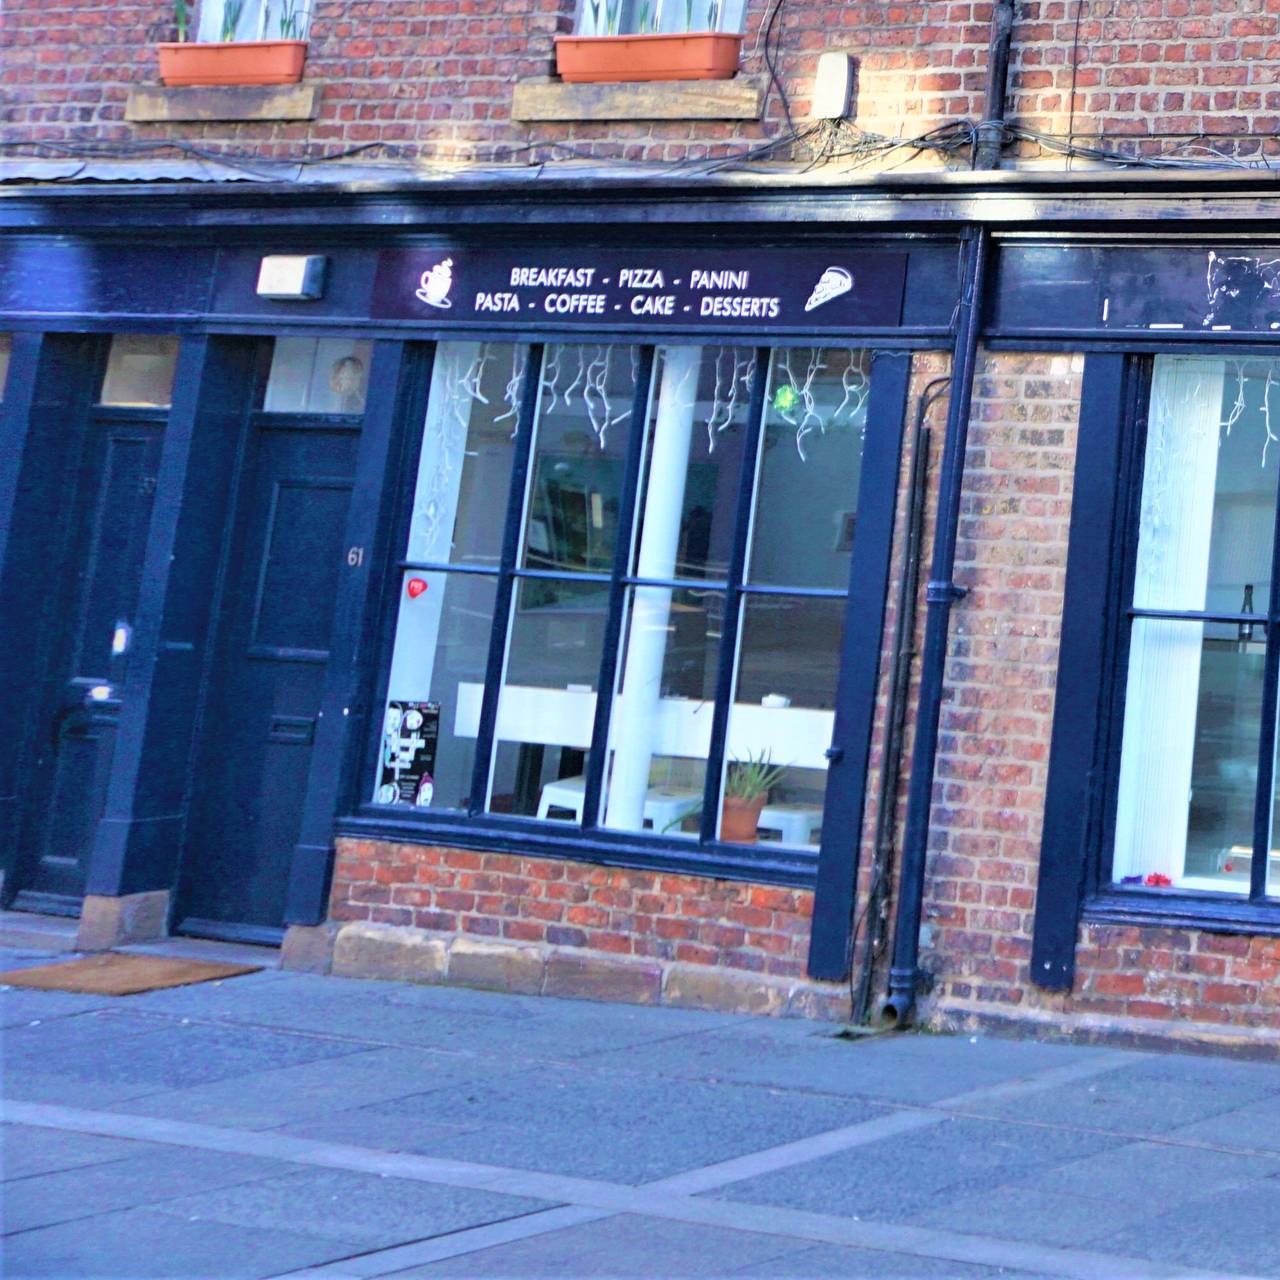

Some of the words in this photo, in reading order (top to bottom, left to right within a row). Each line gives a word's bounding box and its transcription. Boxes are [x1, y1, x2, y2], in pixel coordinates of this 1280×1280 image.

[510, 267, 595, 287] BREAKFAST
[618, 269, 664, 288] PIZZA
[690, 270, 749, 290] PANINI
[474, 292, 519, 312] PASTA
[544, 294, 606, 313] COFFEE
[630, 295, 675, 315] CAKE
[700, 296, 780, 317] DESSERTS
[348, 547, 364, 567] 61
